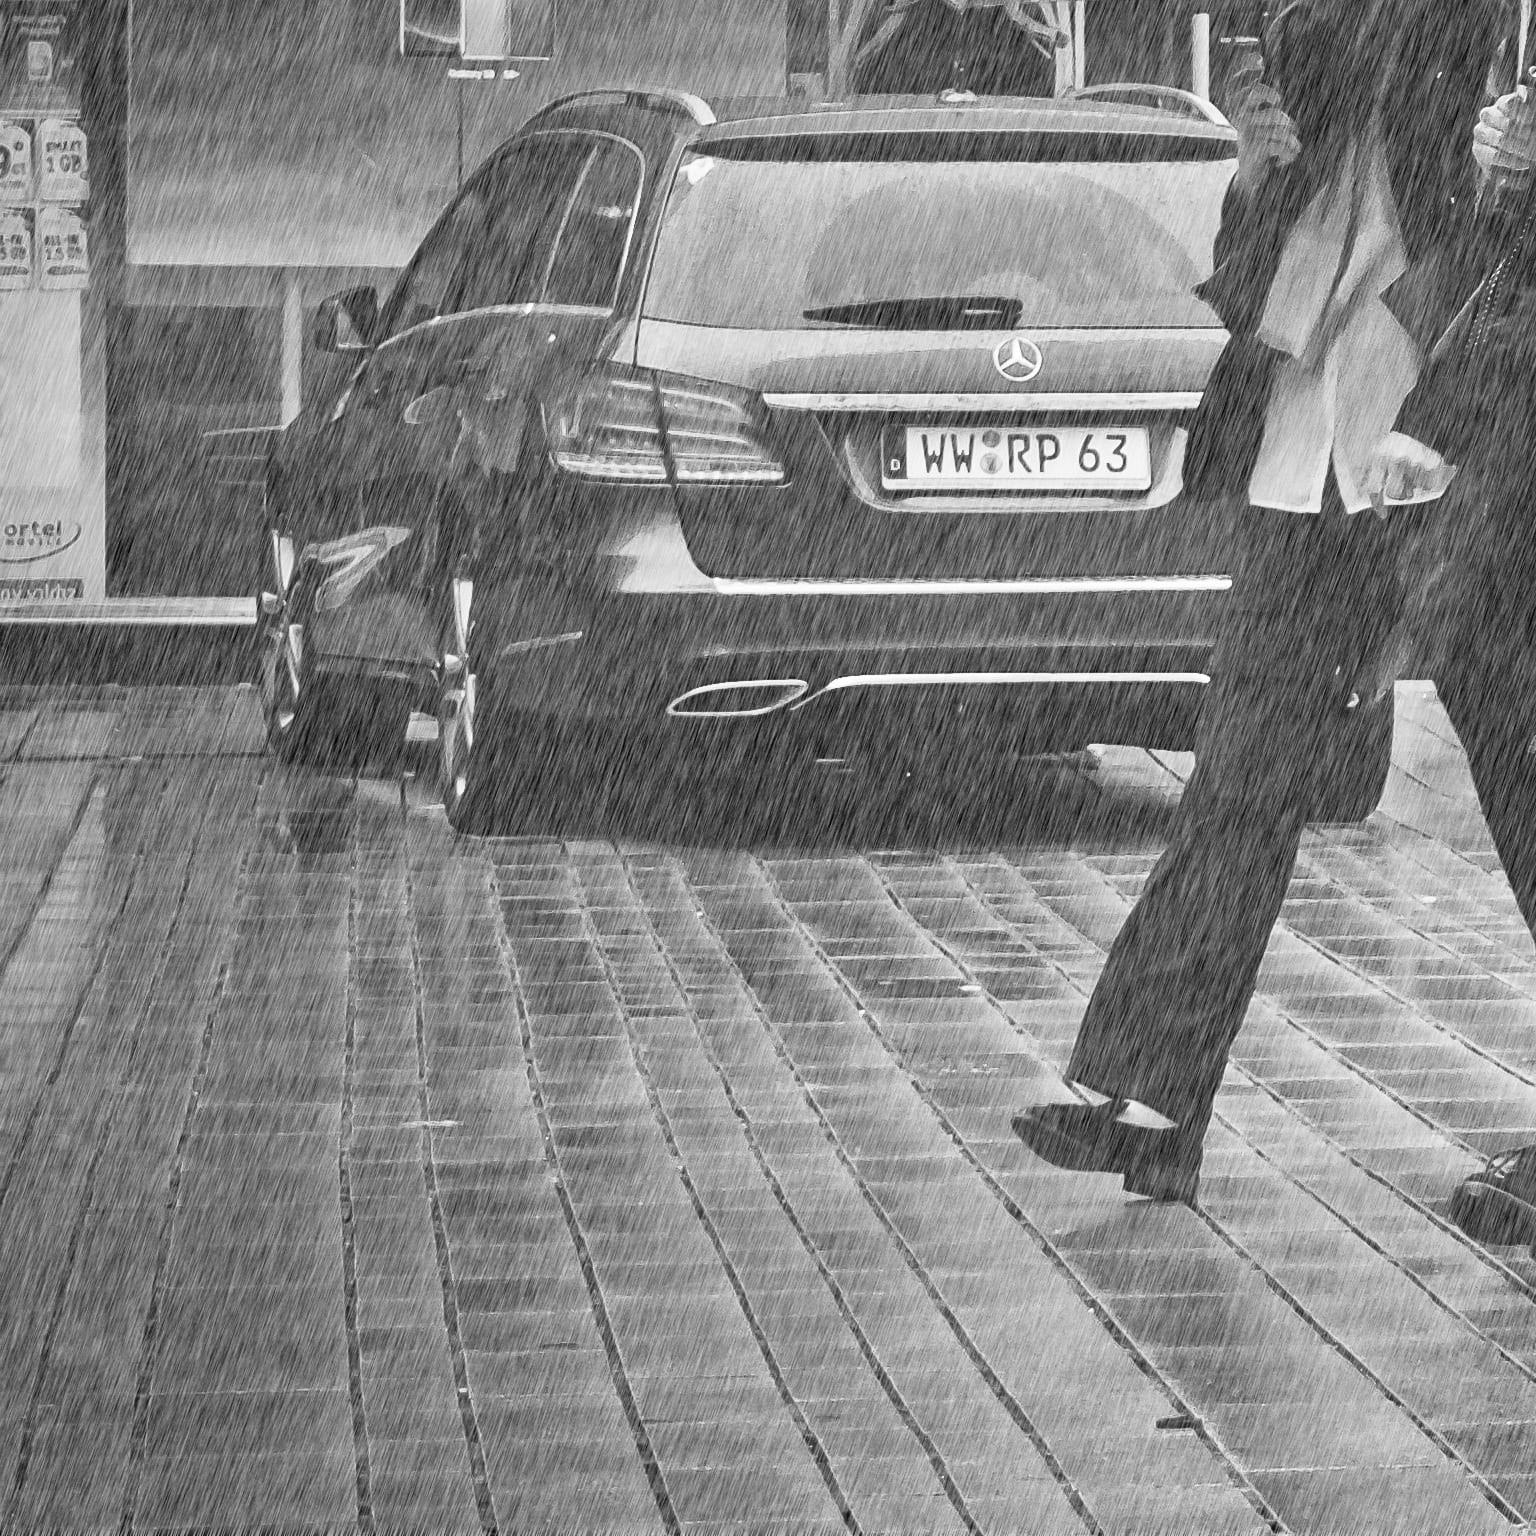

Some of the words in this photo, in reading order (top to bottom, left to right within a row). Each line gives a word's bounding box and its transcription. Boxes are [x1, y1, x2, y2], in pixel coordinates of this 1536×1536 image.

[920, 433, 977, 474] WW
[1006, 433, 1061, 474] RP
[1077, 433, 1129, 473] 63
[4, 520, 61, 537] ortel
